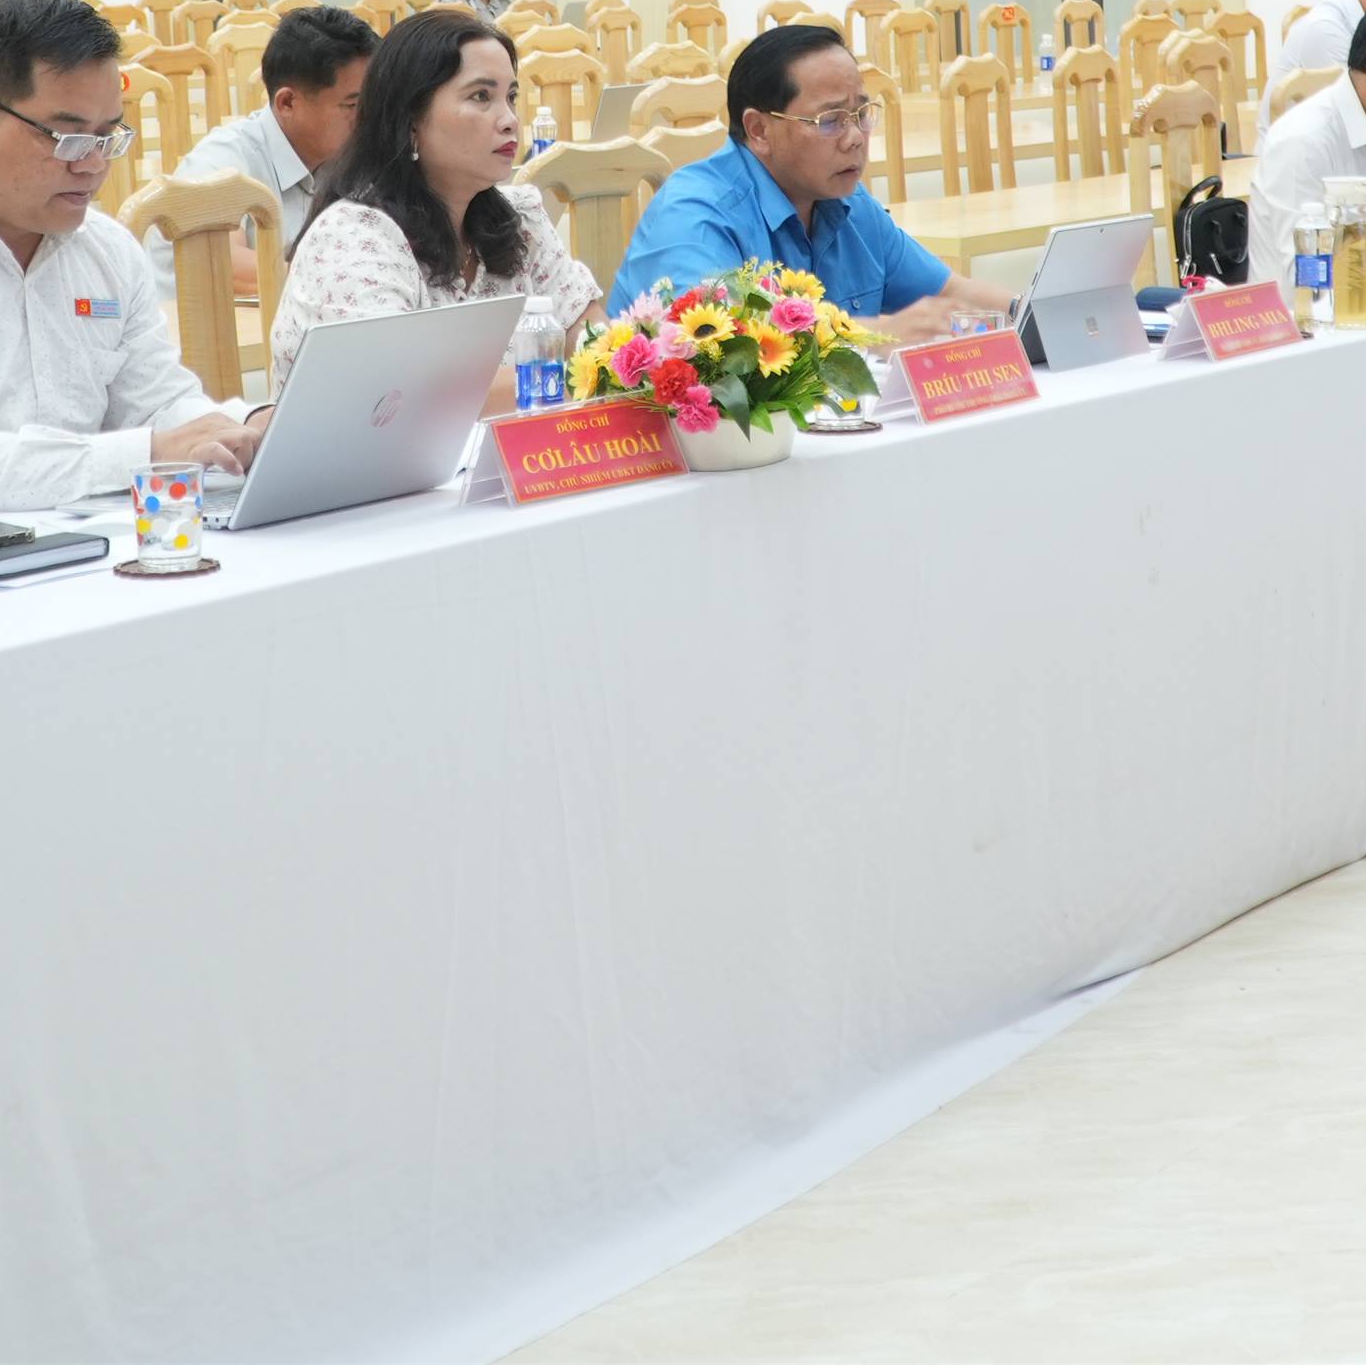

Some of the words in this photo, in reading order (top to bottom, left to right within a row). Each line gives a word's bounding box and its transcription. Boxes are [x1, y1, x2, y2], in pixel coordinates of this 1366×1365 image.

[922, 372, 963, 400] BRÍU
[963, 368, 995, 390] THỊ
[993, 362, 1023, 384] SEN
[556, 418, 588, 434] ĐỒNG
[589, 413, 610, 430] CHÍ
[604, 431, 662, 460] HOÀI
